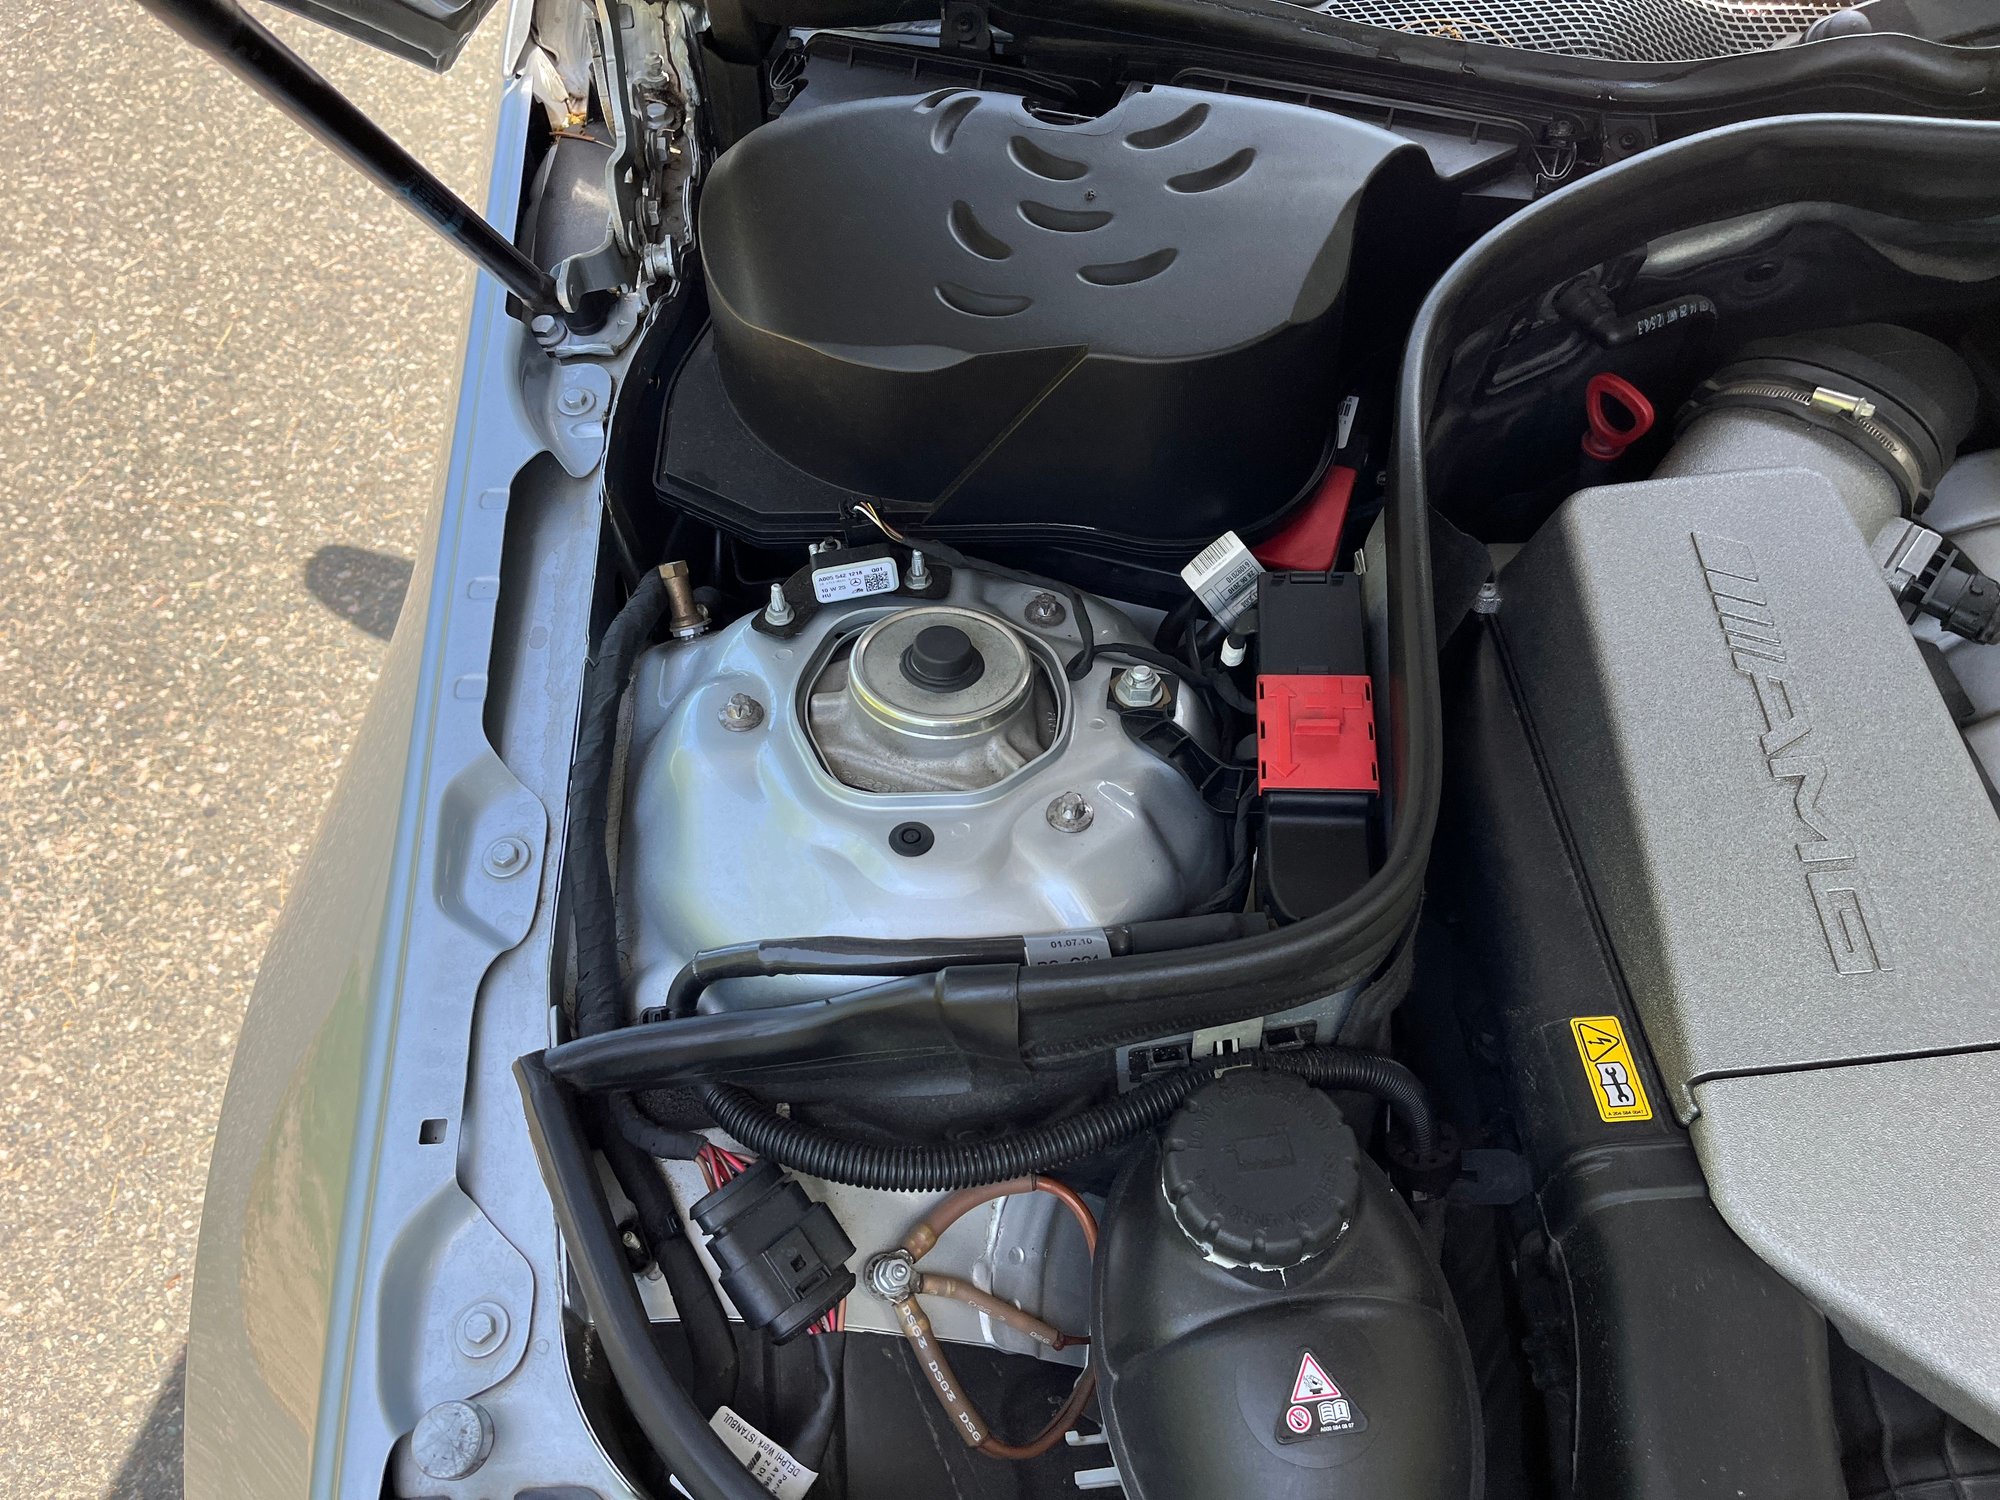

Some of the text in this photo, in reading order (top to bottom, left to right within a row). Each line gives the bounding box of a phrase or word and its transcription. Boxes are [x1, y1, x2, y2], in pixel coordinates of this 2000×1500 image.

[1050, 938, 1092, 948] 01.07.10
[902, 1304, 982, 1442] DSG3 DSG3 DSG
[724, 1412, 800, 1477] DELPHI Werk ISTANBUL
